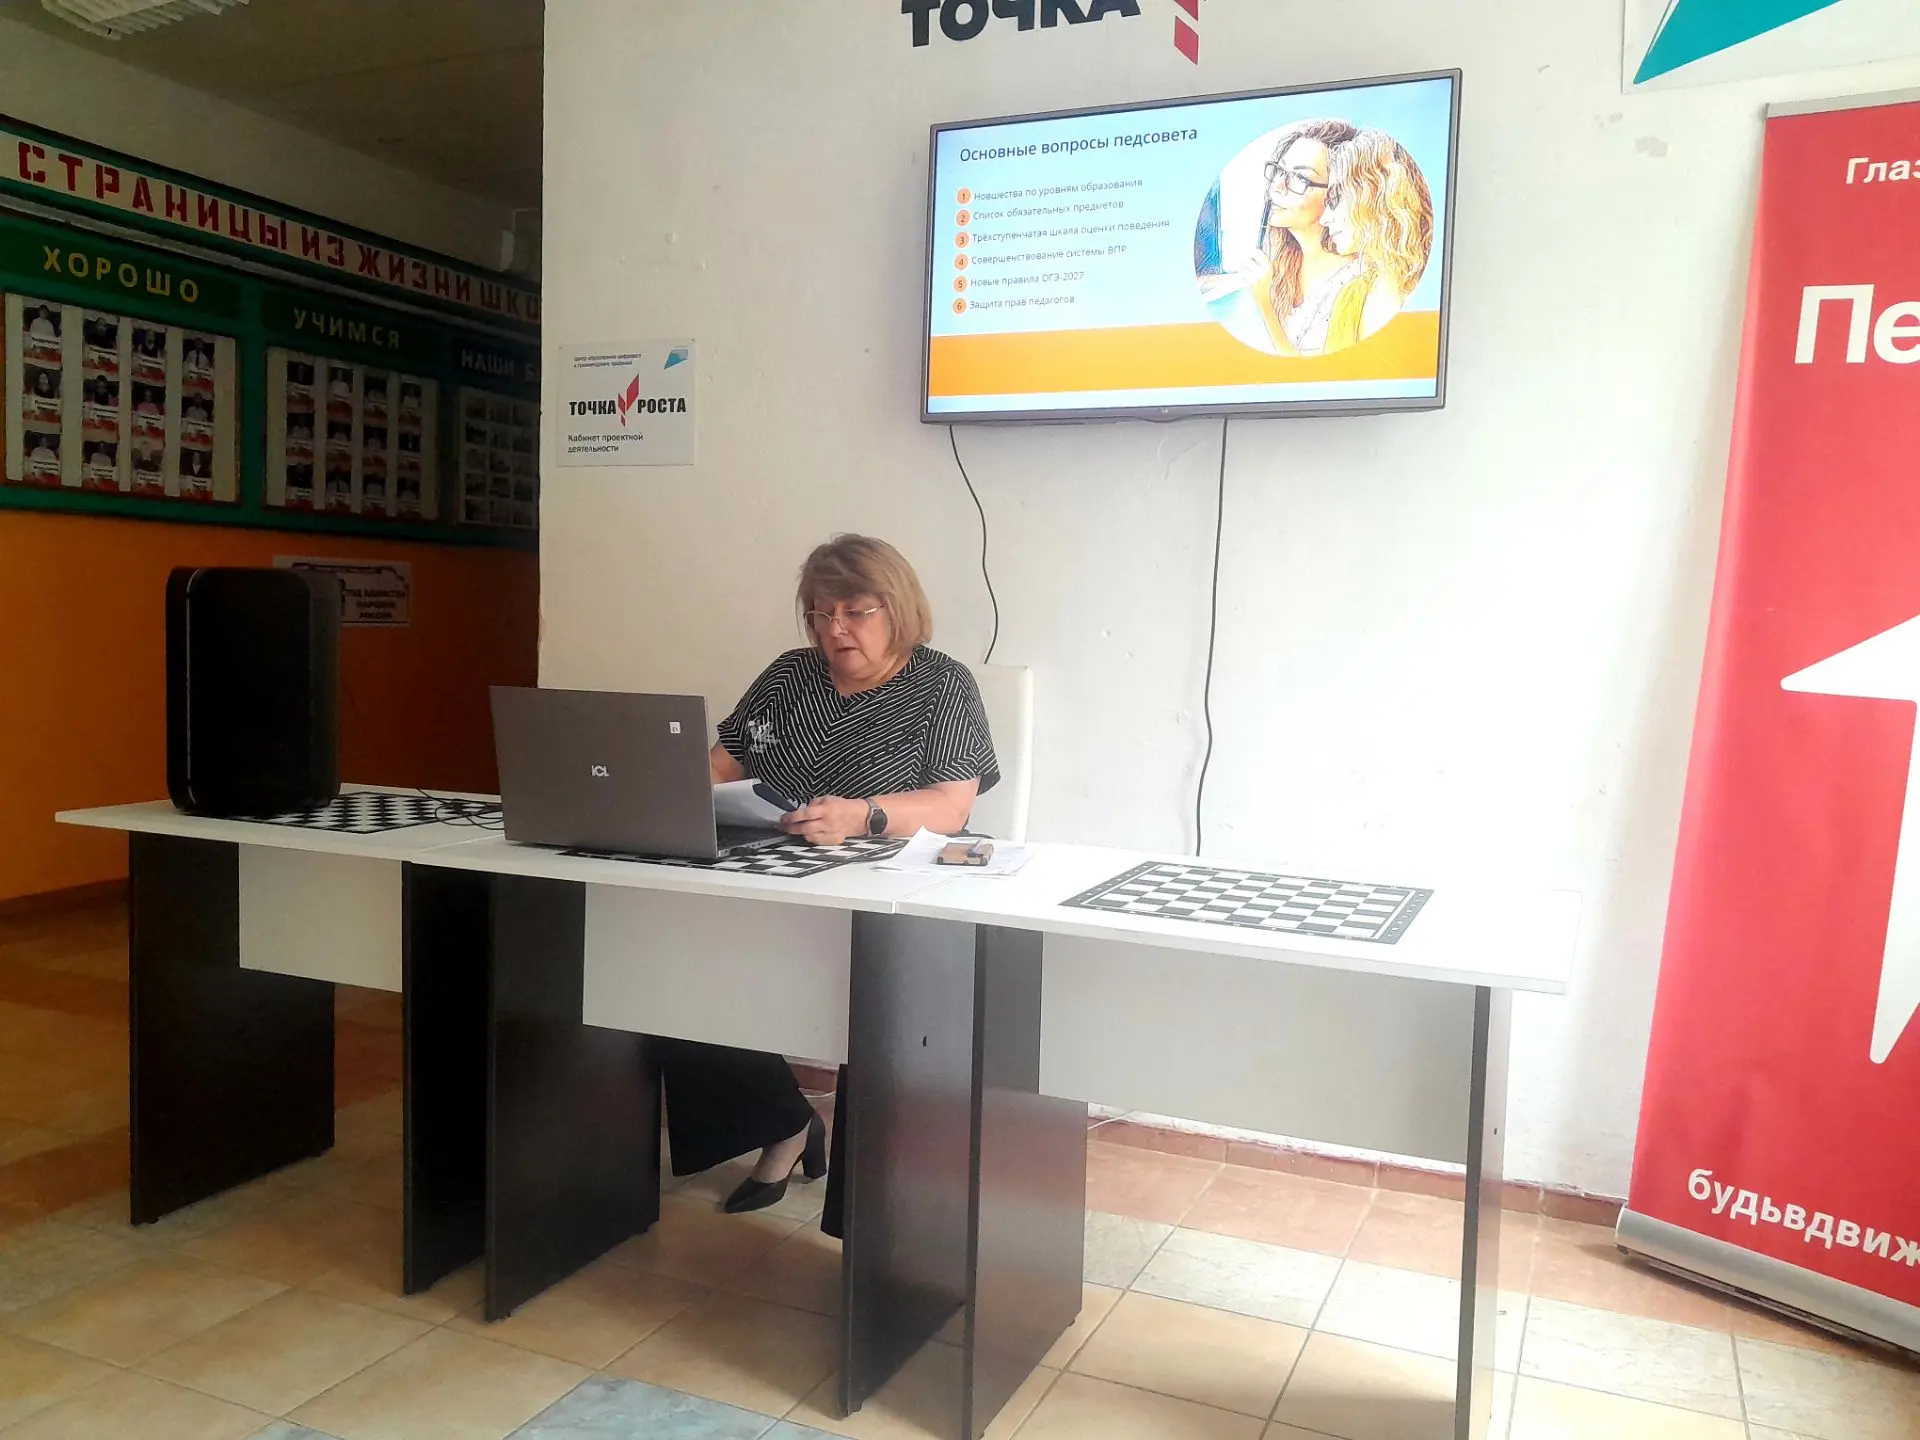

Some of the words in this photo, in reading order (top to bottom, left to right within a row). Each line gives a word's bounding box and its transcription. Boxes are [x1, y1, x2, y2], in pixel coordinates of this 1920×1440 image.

[960, 144, 1037, 162] Основные
[1041, 137, 1109, 155] вопросы
[1114, 128, 1198, 149] педсовета
[974, 190, 1023, 201] Новшества
[1025, 189, 1037, 197] по
[1038, 186, 1079, 198] уровням
[1080, 179, 1143, 194] образования
[18, 141, 287, 250] СТРАНИЦЫ
[301, 226, 345, 267] ИЗ
[358, 244, 470, 302] ЖИЗНИ
[973, 211, 1004, 221] Список
[1006, 205, 1071, 218] обязательных
[1073, 200, 1124, 213] предметов
[972, 230, 1047, 244] Трёхступенчатая
[1049, 227, 1079, 237] шкала
[1080, 224, 1116, 235] оценки
[1117, 219, 1170, 232] поведения
[971, 250, 1064, 265] Совершенствование
[1065, 248, 1105, 259] системы
[1107, 245, 1127, 255] ВПР
[43, 245, 199, 303] ХОРОШО
[970, 277, 1000, 287] Новые
[1001, 275, 1040, 287] правила
[1041, 271, 1085, 283] ОГЭ-2027
[969, 299, 1003, 310] Защита
[1004, 298, 1027, 309] прав
[1028, 294, 1075, 307] педагогов
[292, 307, 400, 350] УЧИМСЯ
[1795, 284, 1920, 364] Пе
[461, 347, 515, 377] НАШИ
[569, 400, 617, 415] ТОЧКА
[637, 398, 687, 413] РОСТА
[567, 444, 619, 453] деятельности
[568, 434, 600, 442] Кабинет
[602, 431, 644, 443] проектной
[1688, 1168, 1920, 1267] будьвдвиж
